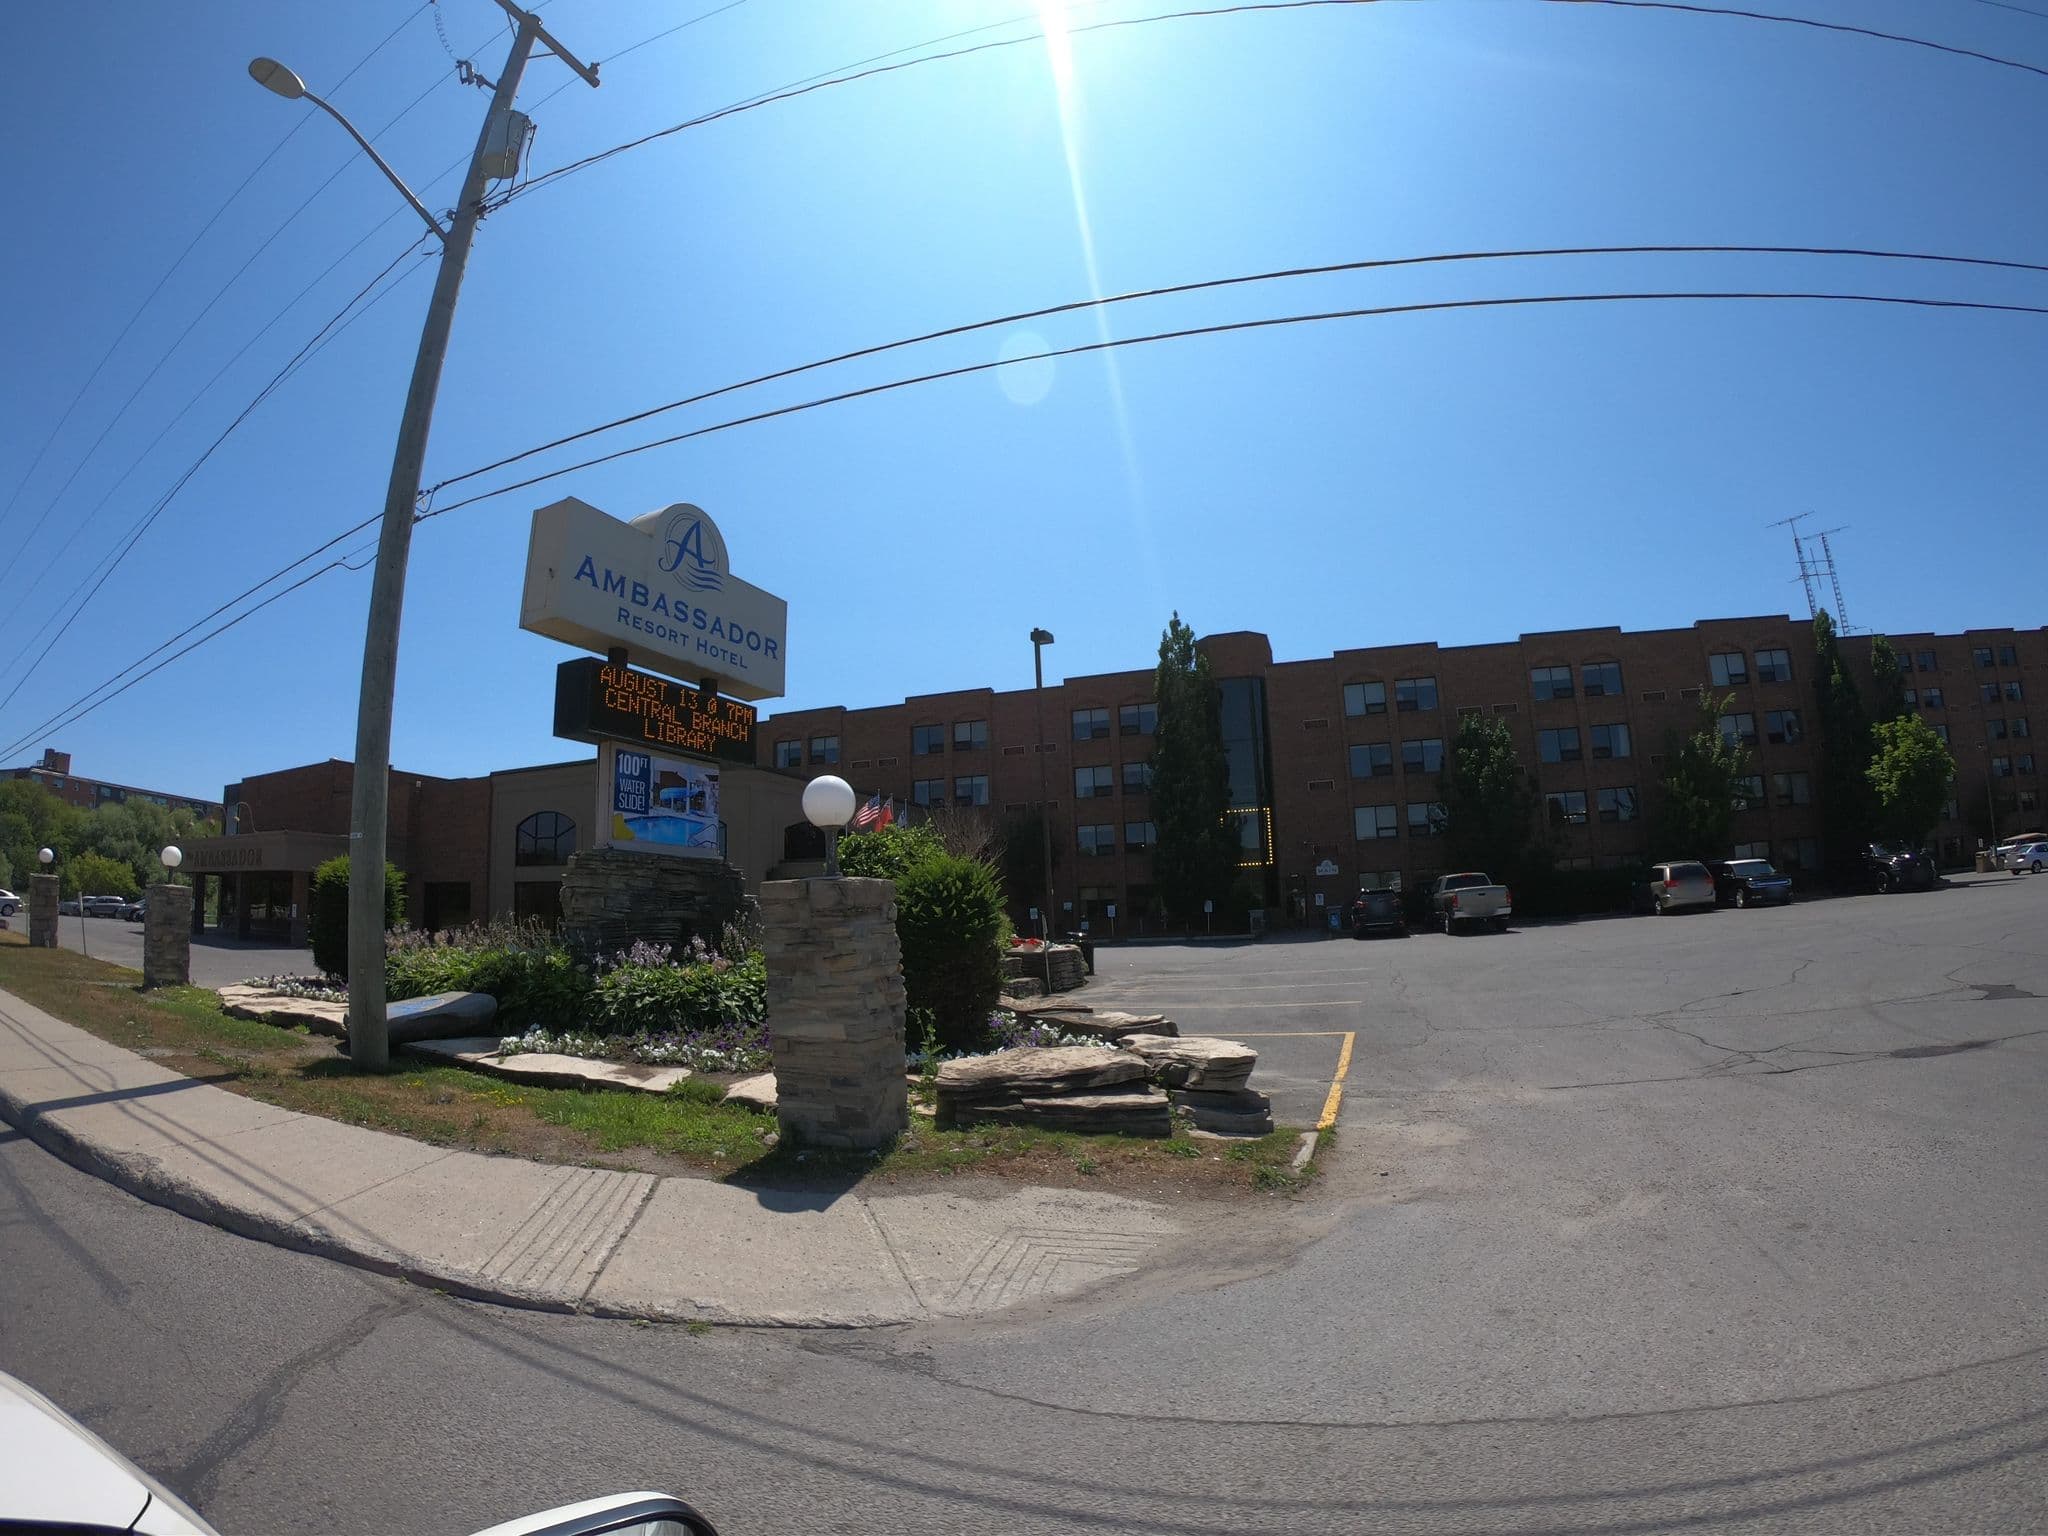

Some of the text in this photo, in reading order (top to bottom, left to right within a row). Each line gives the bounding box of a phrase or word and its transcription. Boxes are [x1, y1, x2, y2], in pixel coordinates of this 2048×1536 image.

[574, 555, 779, 660] AMBASSADOR
[617, 607, 748, 669] RESORT HOTEL
[600, 665, 753, 726] AUGUST 13 @ 7PM
[605, 687, 749, 742] CENTRAL BRANCH
[644, 718, 716, 752] LIBRARY
[618, 792, 646, 811] SLIDE!
[619, 778, 646, 795] WATER
